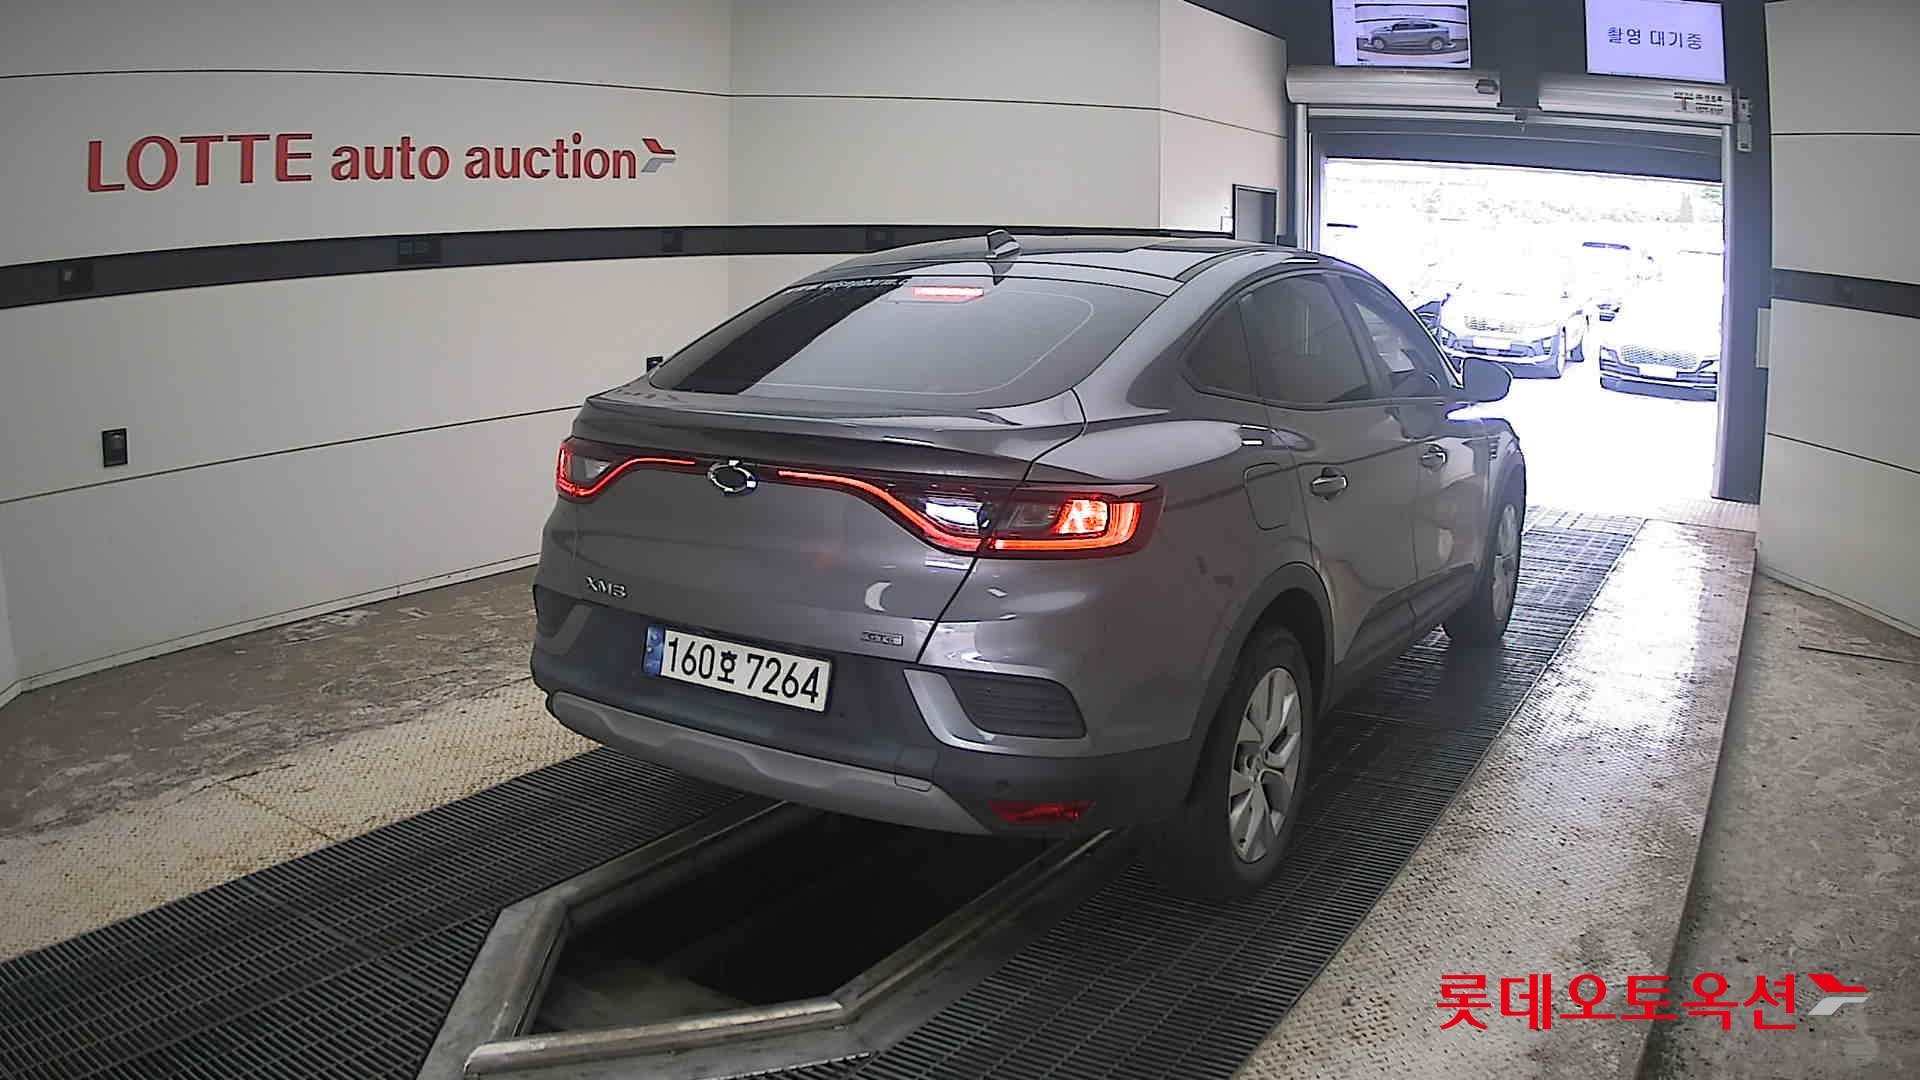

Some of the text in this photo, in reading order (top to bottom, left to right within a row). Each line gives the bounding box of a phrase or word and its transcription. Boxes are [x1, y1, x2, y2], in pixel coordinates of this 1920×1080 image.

[1607, 26, 1641, 46] 촬영
[88, 132, 638, 193] LOTTE auto auction
